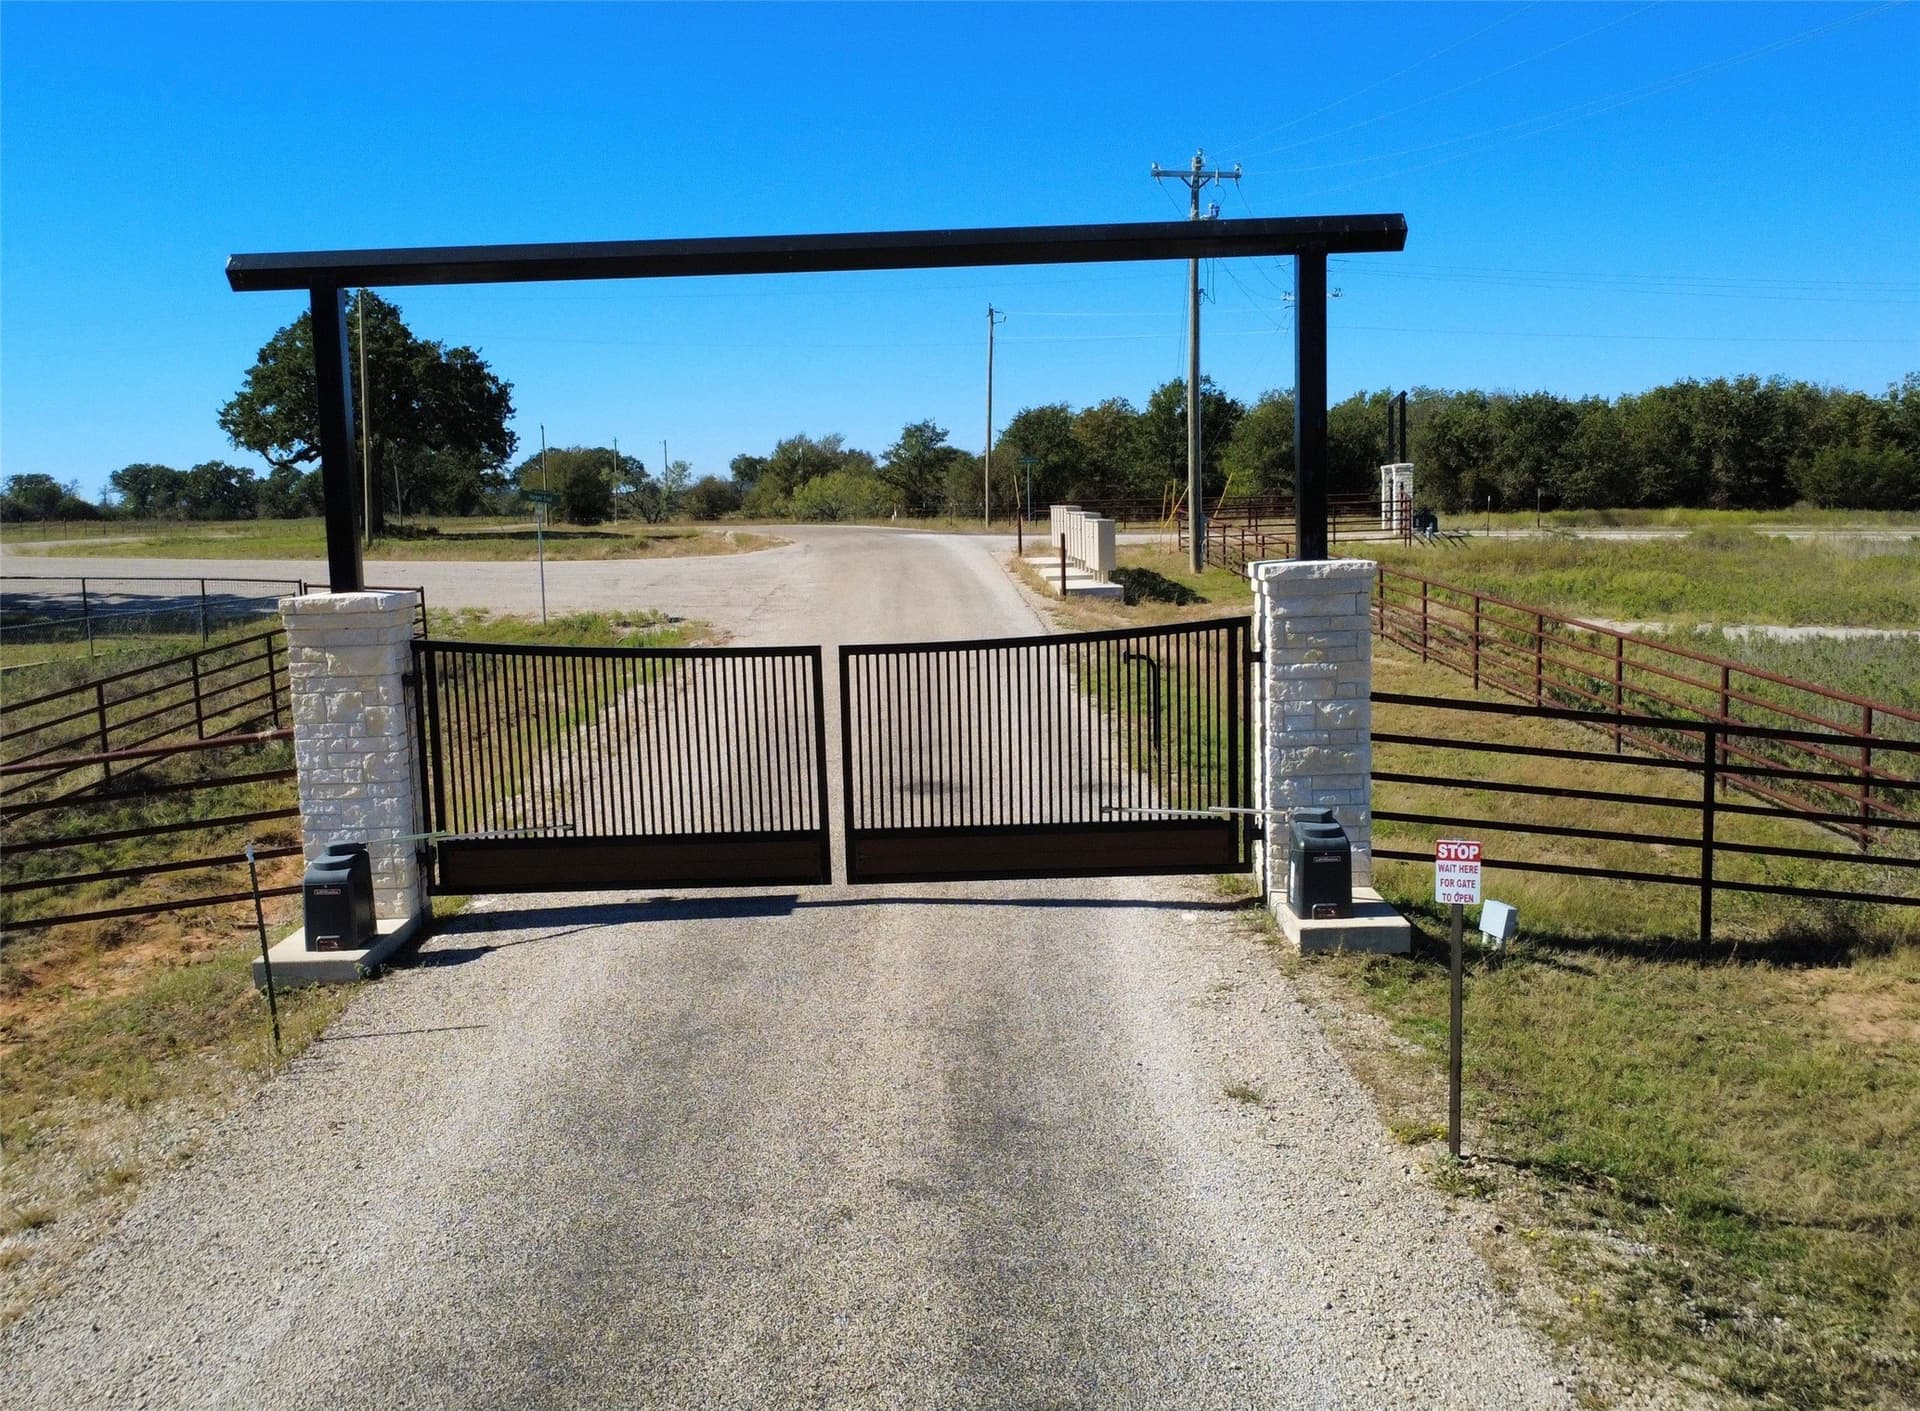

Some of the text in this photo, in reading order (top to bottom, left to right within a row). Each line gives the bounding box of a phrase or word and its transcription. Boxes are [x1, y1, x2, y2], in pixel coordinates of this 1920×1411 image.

[1438, 844, 1479, 860] STOP
[1438, 864, 1479, 874] WAIT HERE
[1440, 879, 1477, 888] FOR GATE
[1442, 893, 1474, 903] TO OPEN
